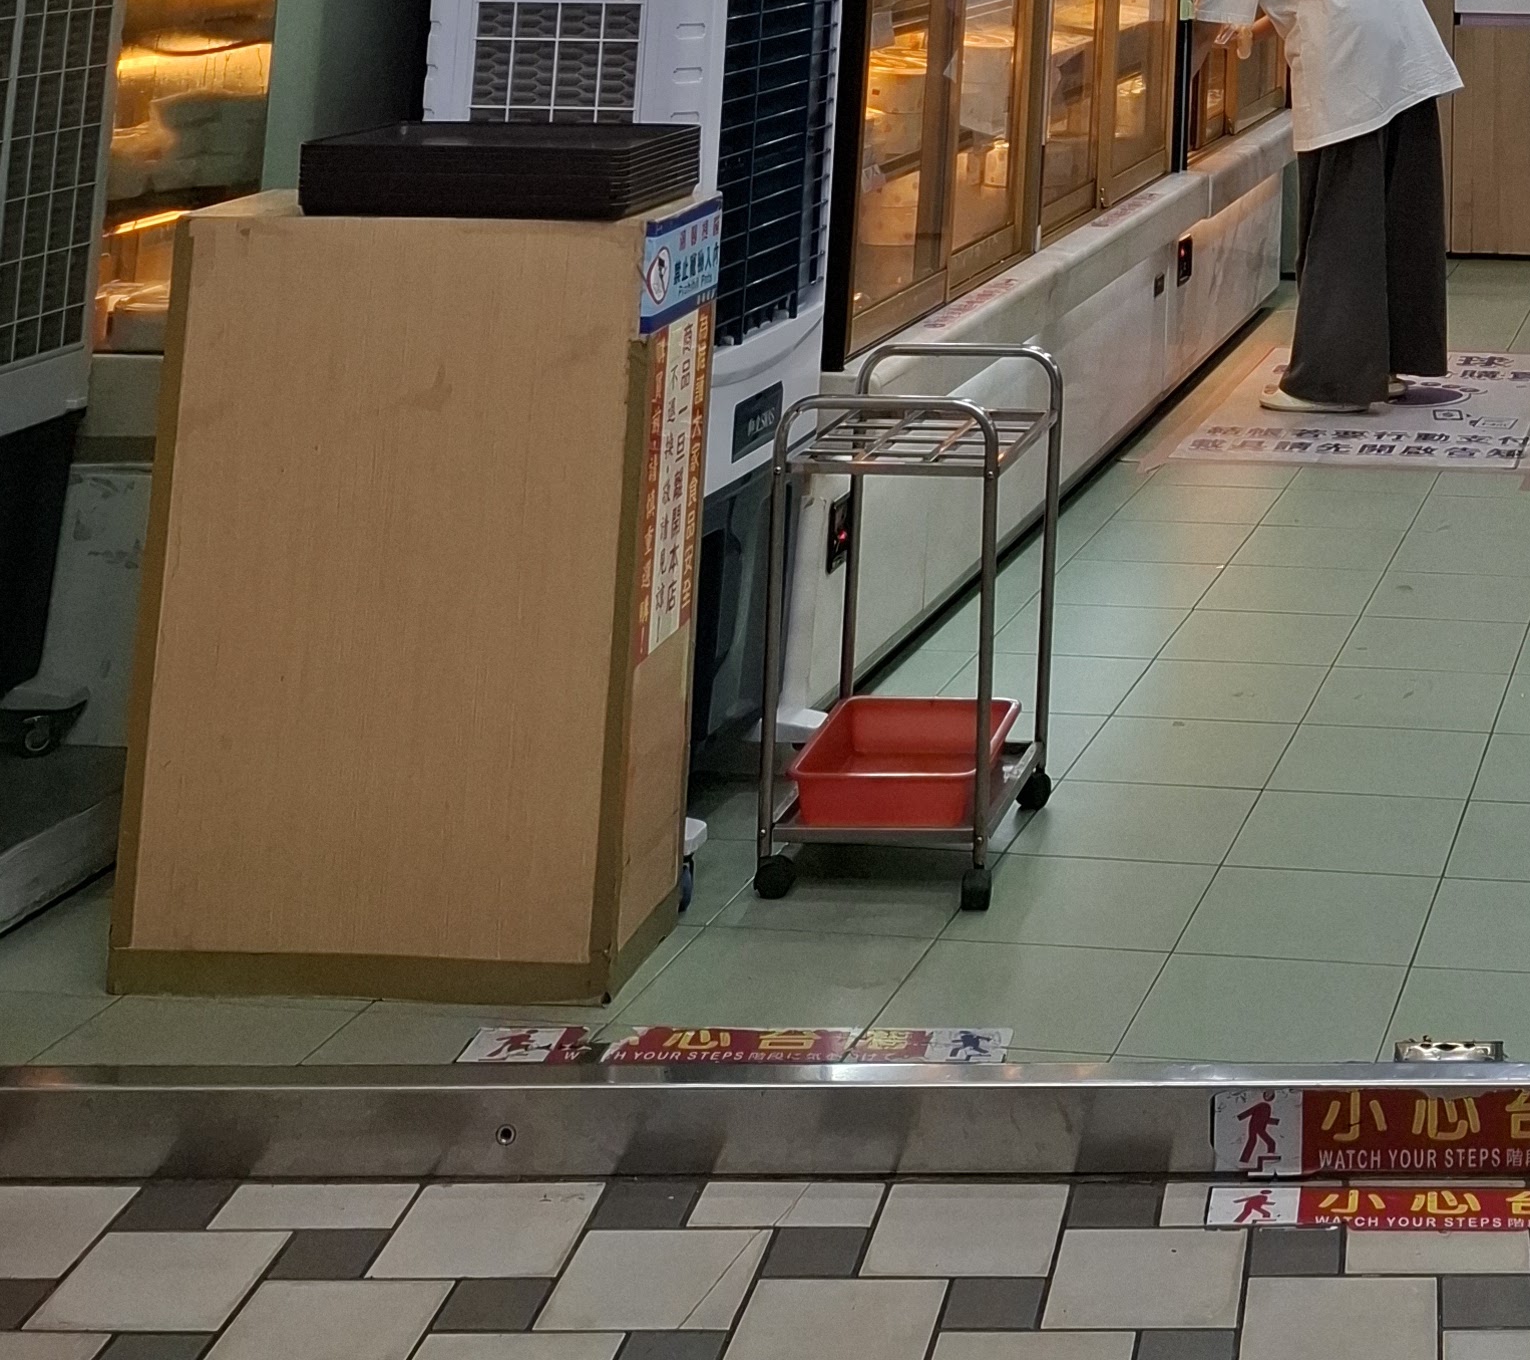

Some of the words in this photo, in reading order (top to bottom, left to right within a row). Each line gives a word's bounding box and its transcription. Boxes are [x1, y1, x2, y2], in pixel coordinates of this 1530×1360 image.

[632, 1051, 682, 1061] YOUR
[687, 1051, 744, 1061] STEPS
[1319, 1149, 1381, 1169] WATCH
[1388, 1148, 1437, 1169] YOUR
[1444, 1148, 1501, 1168] STEPS
[1315, 1216, 1379, 1227] WATCH
[1386, 1216, 1436, 1227] YOUR
[1444, 1217, 1502, 1228] STEPS
